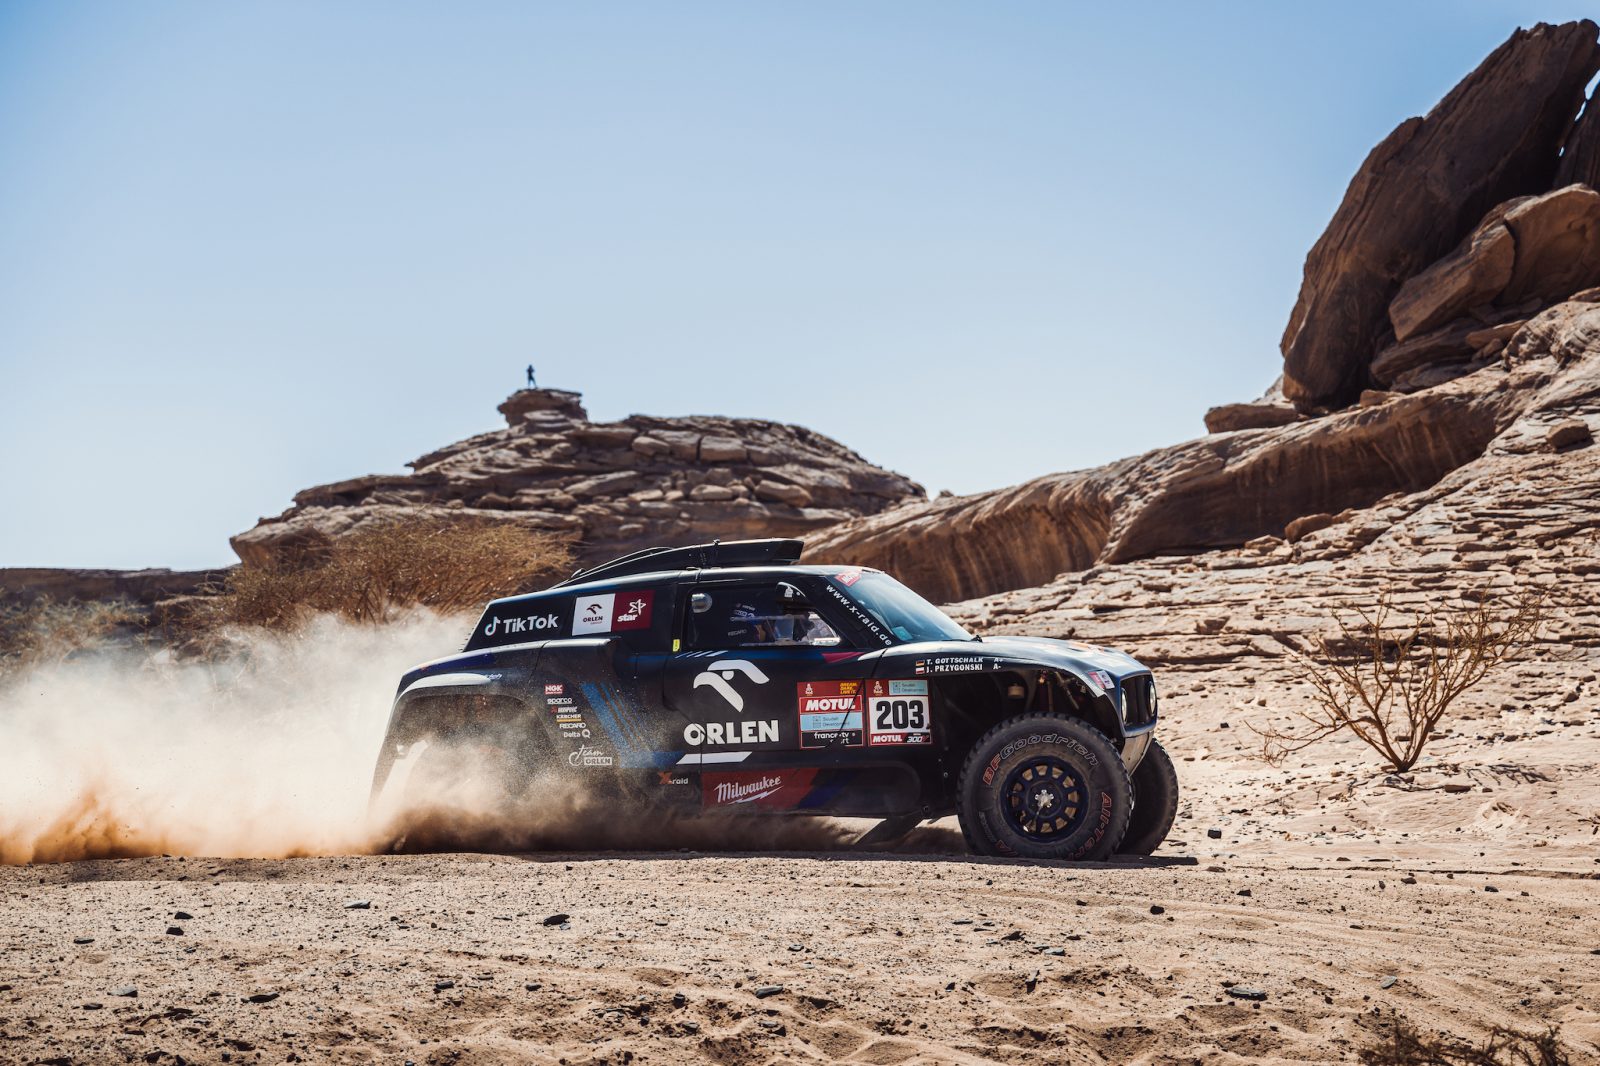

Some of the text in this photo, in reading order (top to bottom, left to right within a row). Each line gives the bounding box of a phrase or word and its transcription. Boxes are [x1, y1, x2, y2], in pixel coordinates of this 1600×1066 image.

[503, 614, 559, 633] TikTok
[617, 614, 638, 622] star
[826, 585, 892, 645] www.x-raid.de
[935, 657, 983, 665] GOTTSCHALK
[805, 698, 856, 711] MOTUL
[876, 700, 924, 730] 203
[581, 729, 591, 739] Q
[684, 720, 779, 746] ORLEN
[873, 735, 902, 743] MOTUL
[983, 733, 1099, 786] BFGoodrich
[713, 775, 781, 803] Milwaukee
